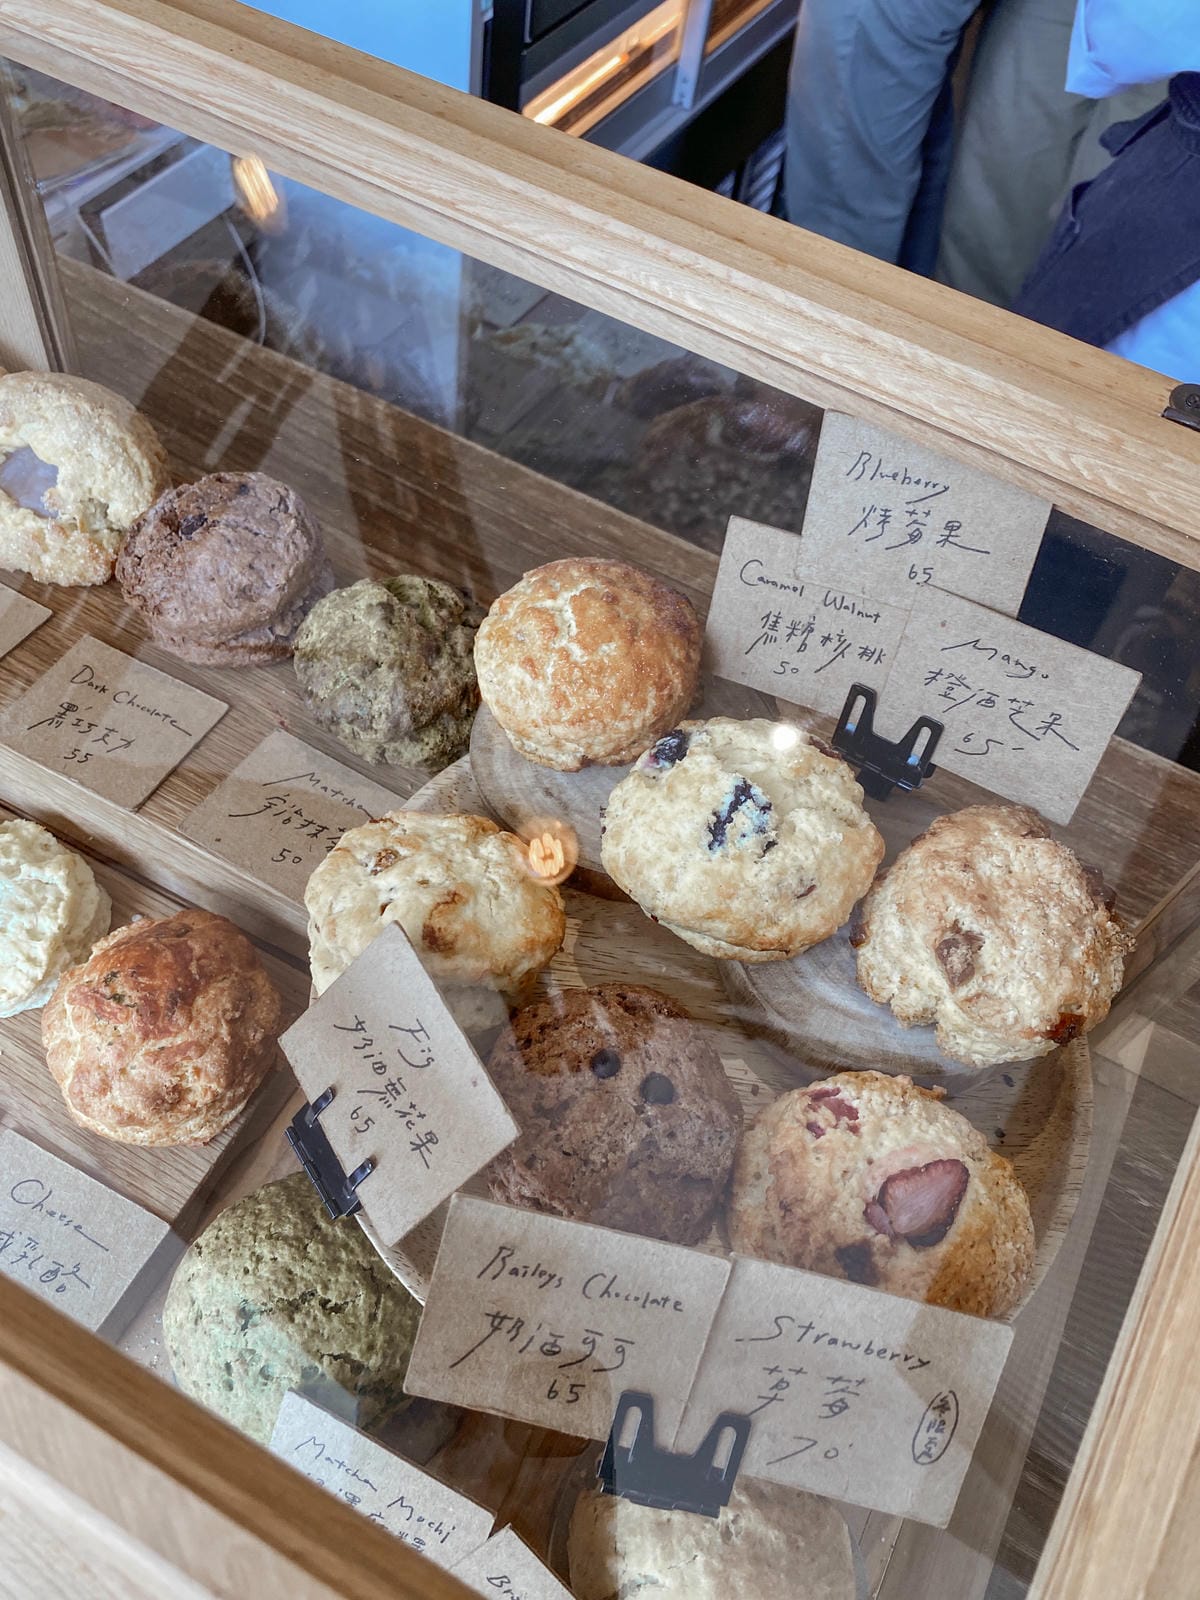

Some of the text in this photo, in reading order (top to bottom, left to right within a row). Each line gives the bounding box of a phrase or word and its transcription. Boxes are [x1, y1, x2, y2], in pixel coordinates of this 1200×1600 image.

[846, 450, 950, 504] Blueberry
[908, 563, 934, 583] 65
[823, 590, 881, 624] Walnut
[744, 610, 887, 674] 焦糖核桃
[940, 638, 1049, 679] Mango
[773, 660, 799, 675] 50
[70, 664, 193, 737] Dark Chocolate
[27, 701, 136, 753] 黑巧克力
[63, 748, 93, 763] 55
[261, 771, 375, 821] Matcha
[271, 848, 303, 864] 50
[350, 1105, 376, 1133] 65
[10, 1178, 110, 1252] Cheese
[476, 1245, 684, 1313] Baileys Chocolate
[735, 1315, 932, 1372] Strawberry
[546, 1379, 587, 1404] 65
[294, 1435, 378, 1493] Matcha
[386, 1495, 457, 1545] Mochi
